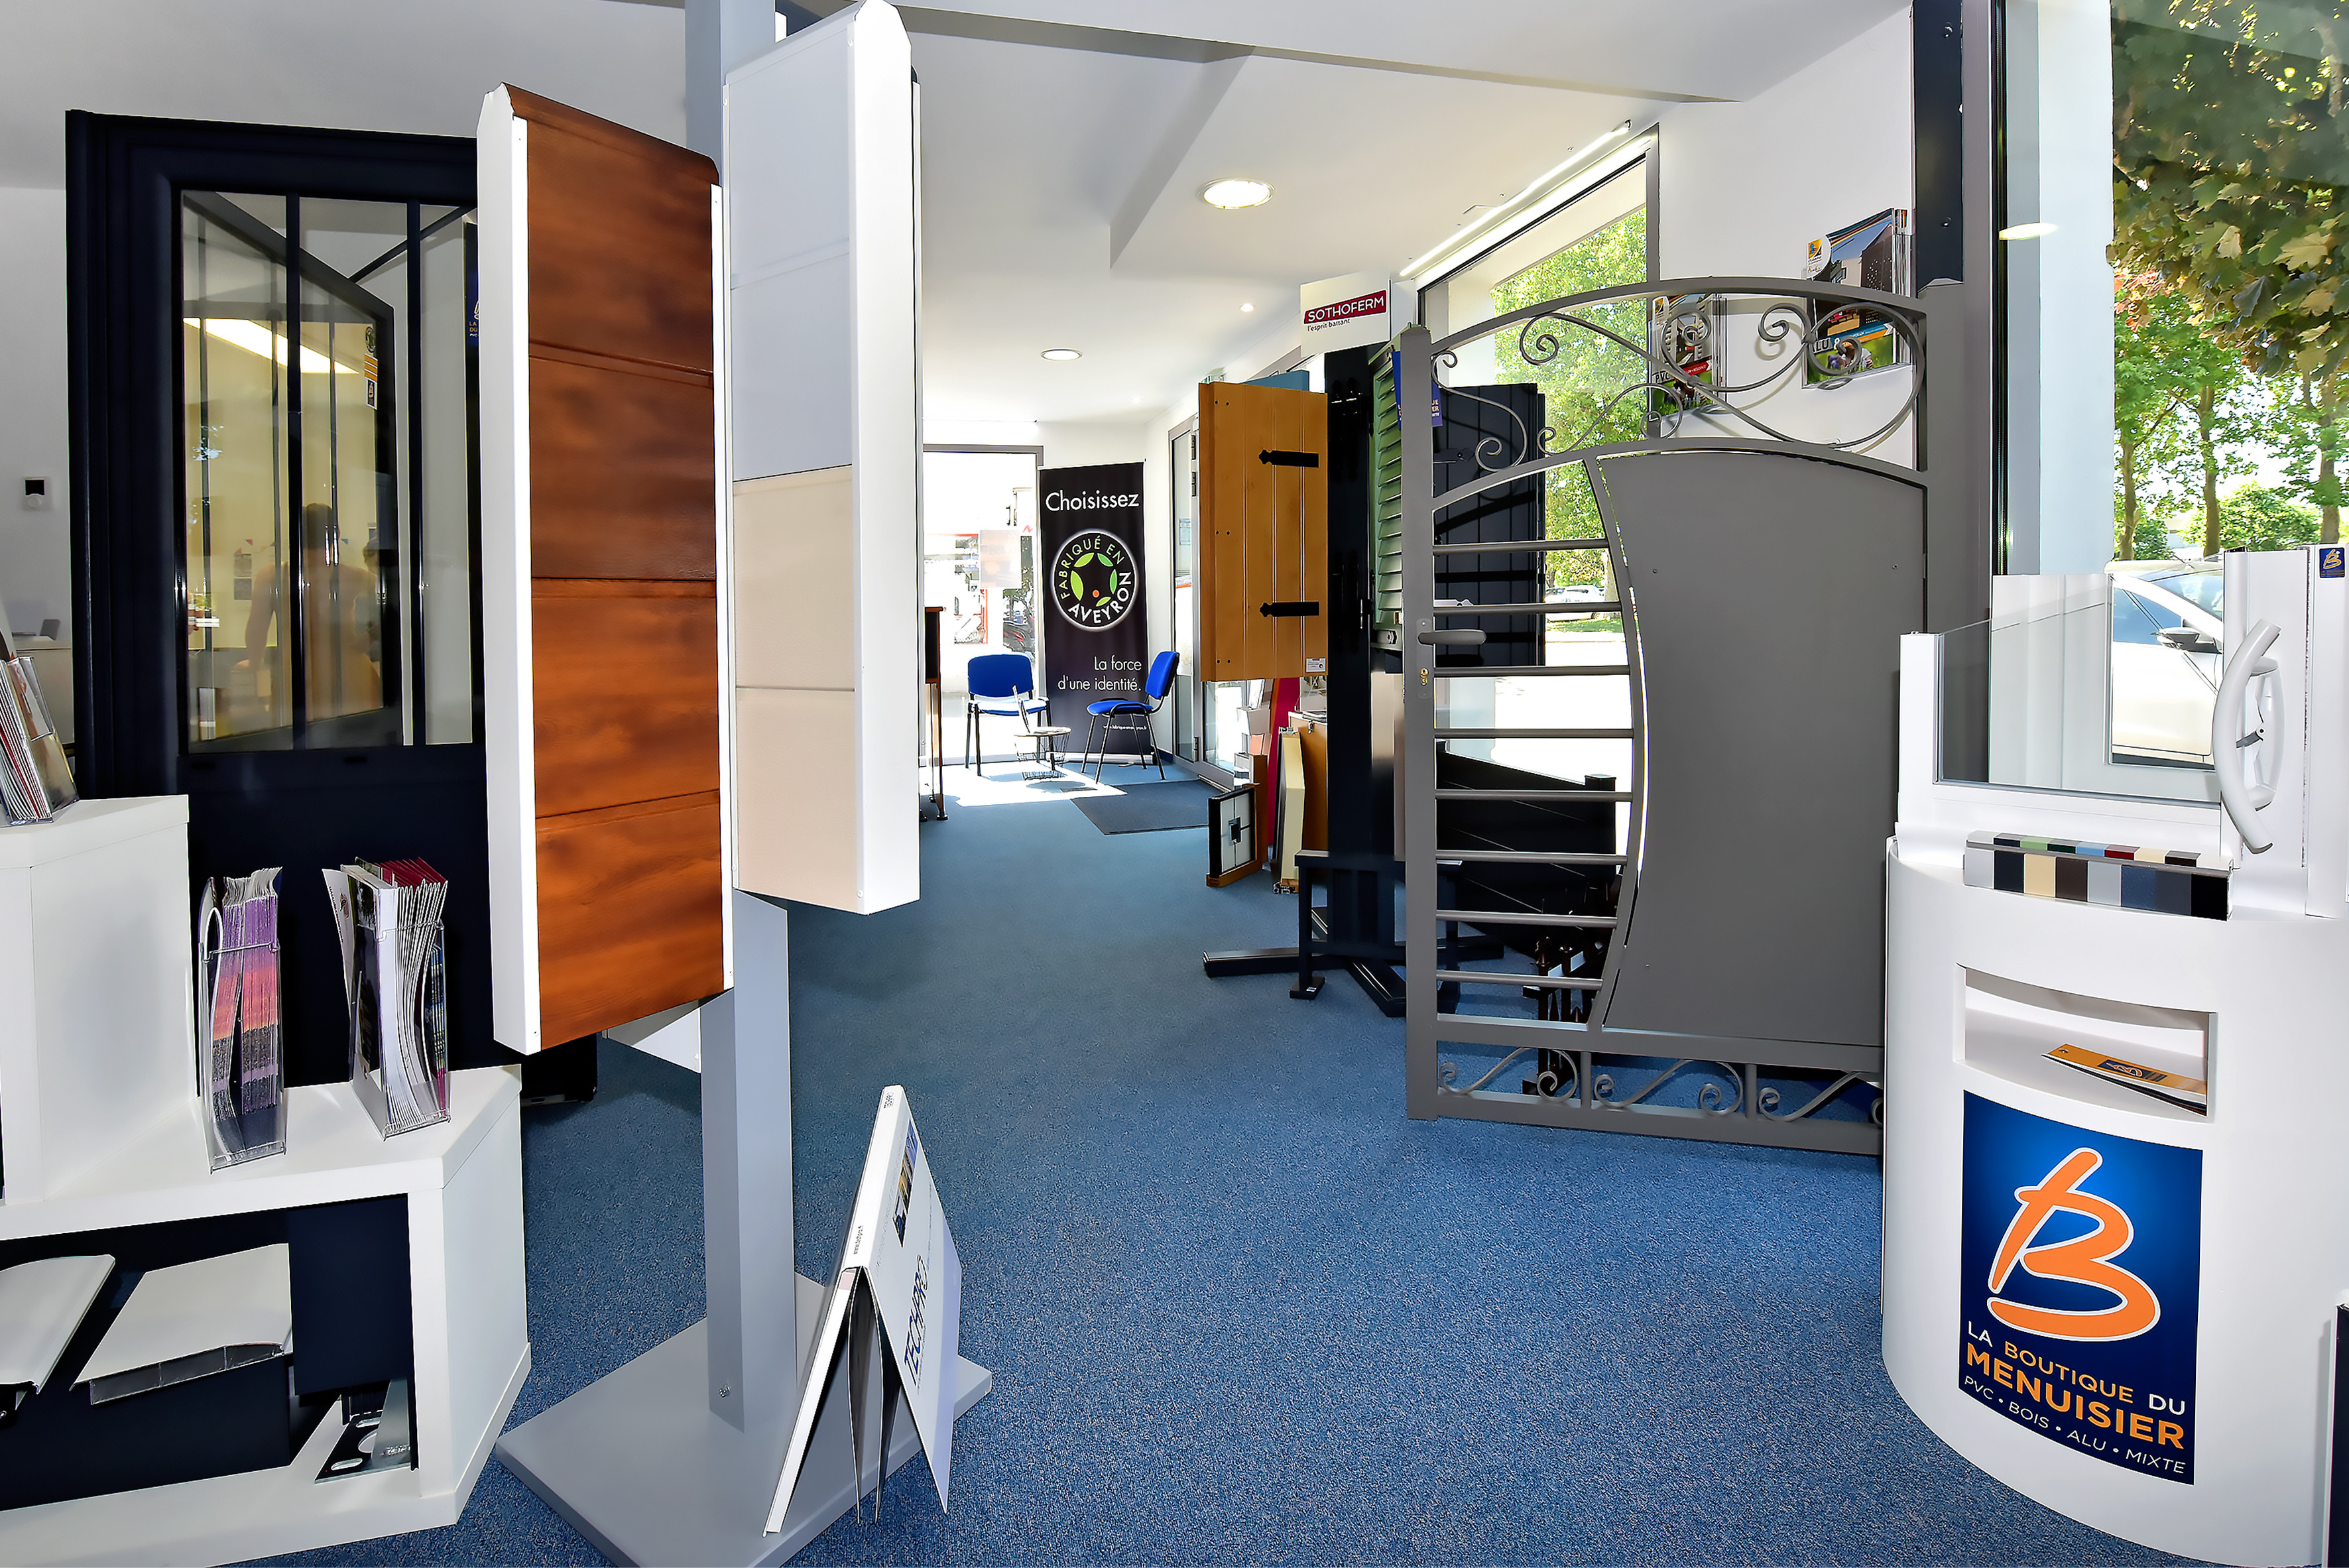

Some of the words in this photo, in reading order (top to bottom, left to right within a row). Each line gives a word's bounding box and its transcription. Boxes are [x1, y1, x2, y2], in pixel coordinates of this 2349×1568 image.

[1308, 296, 1384, 322] SOTHOFERM
[1329, 319, 1351, 328] battant
[1046, 489, 1140, 511] Choisissez
[1059, 535, 1101, 599] FABRIQUÉ
[1106, 544, 1124, 564] EN
[1067, 572, 1132, 624] AVEYRON
[1057, 674, 1091, 690] d'une
[1095, 675, 1142, 692] identité.
[1094, 656, 1107, 670] La
[1111, 654, 1142, 670] force
[905, 1254, 928, 1386] TECHPRO
[1968, 1320, 1992, 1348] LA
[2005, 1341, 2134, 1404] BOUTIQUE
[2149, 1394, 2185, 1416] DU
[1967, 1342, 2184, 1449] MENUISIER
[1964, 1375, 1994, 1400] PVC
[2009, 1400, 2049, 1429] BOIS
[2067, 1429, 2106, 1451] ALU
[2126, 1448, 2186, 1474] MIXTE
